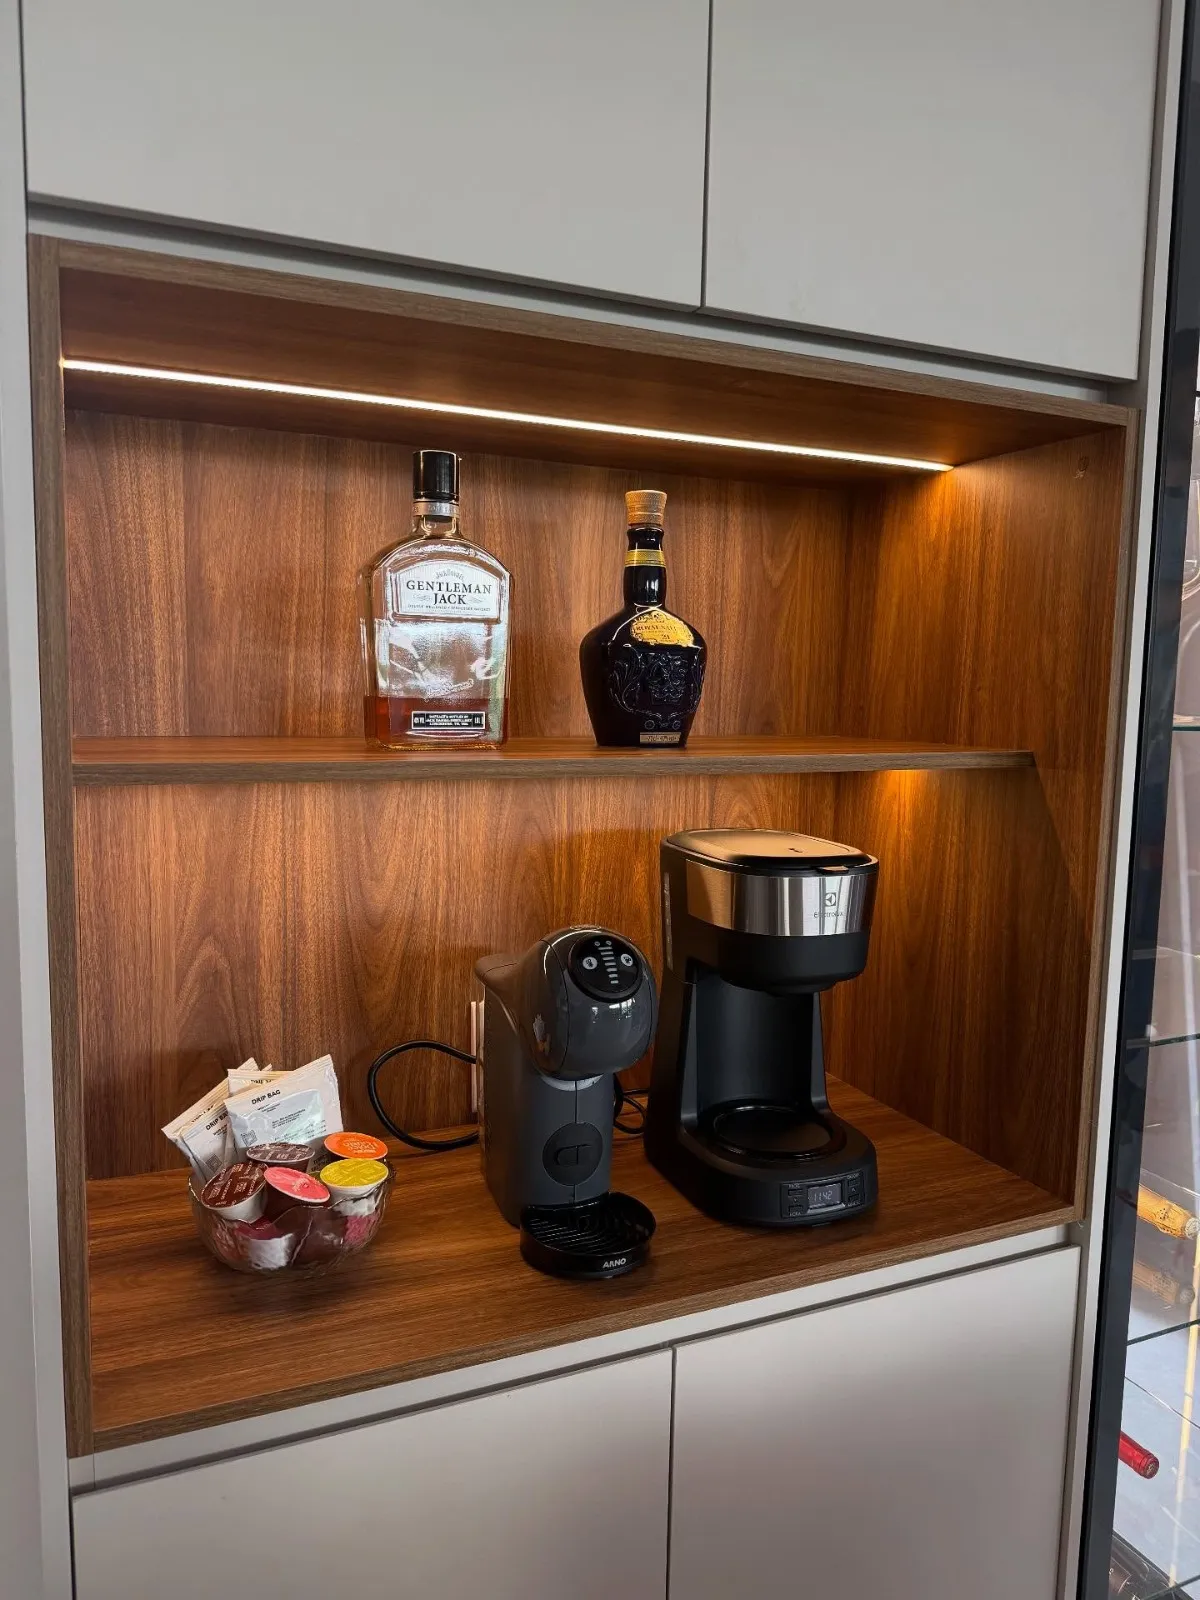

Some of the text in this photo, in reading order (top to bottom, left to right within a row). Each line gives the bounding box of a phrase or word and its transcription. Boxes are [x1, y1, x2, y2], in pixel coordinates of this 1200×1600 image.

[406, 579, 492, 595] GENTLEMAN
[433, 593, 467, 606] JACK
[813, 911, 844, 919] Ectrolux
[251, 1089, 281, 1105] DRIP BAG
[205, 1118, 219, 1131] DRIP
[602, 1257, 627, 1269] ARNO
